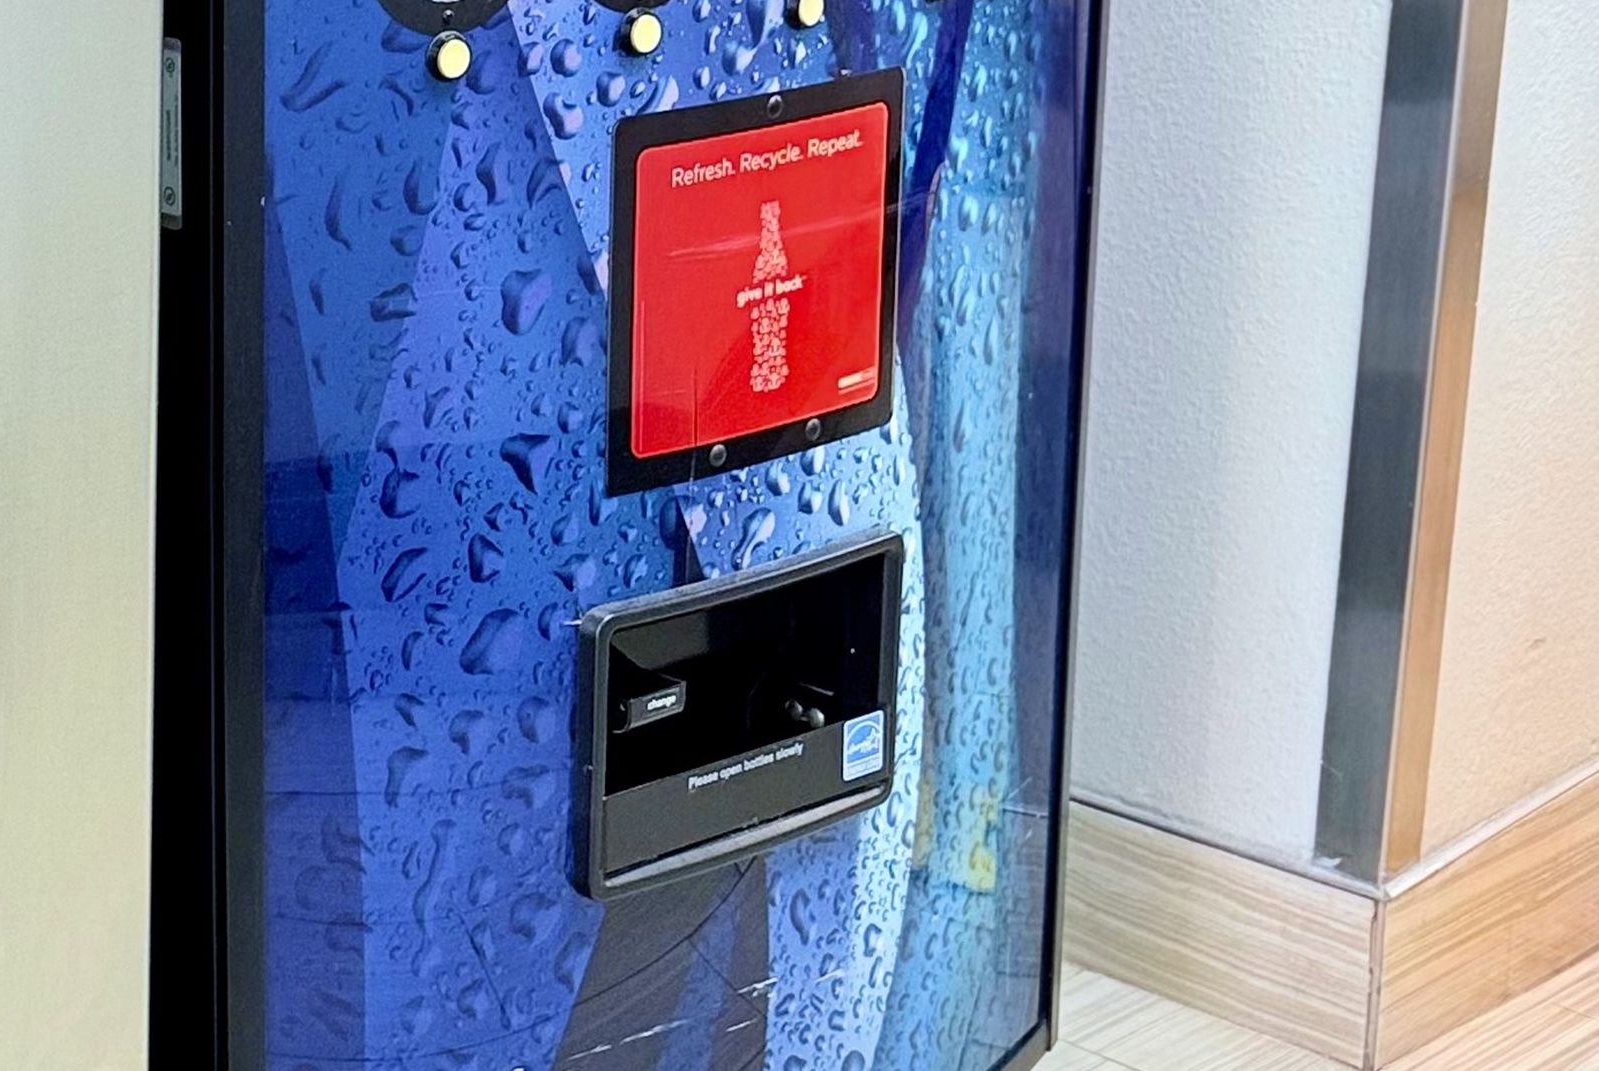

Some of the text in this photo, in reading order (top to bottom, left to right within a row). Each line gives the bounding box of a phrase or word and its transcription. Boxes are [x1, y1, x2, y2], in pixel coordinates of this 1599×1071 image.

[671, 129, 865, 189] Refresh. Recycle. Repeat.
[736, 286, 763, 308] give
[688, 742, 804, 790] Please open bottles slowly
